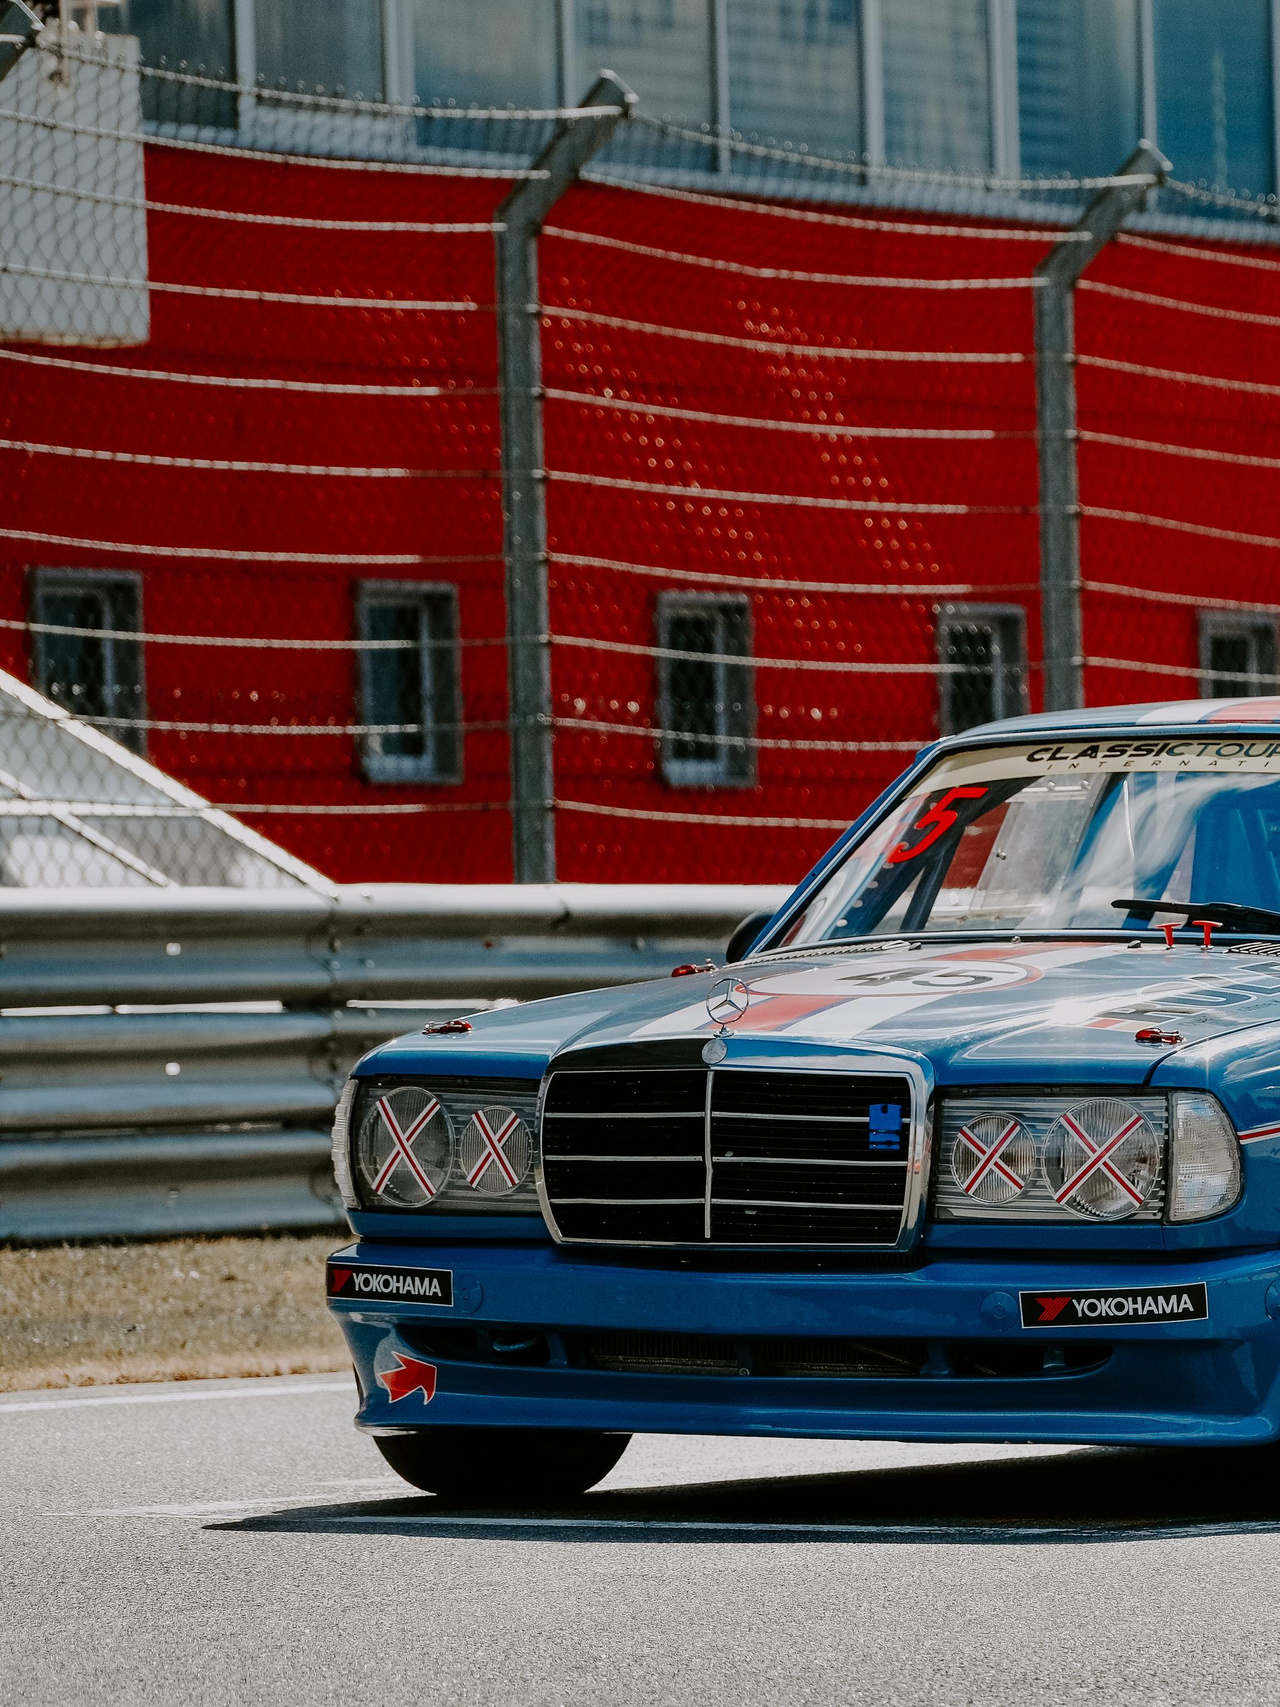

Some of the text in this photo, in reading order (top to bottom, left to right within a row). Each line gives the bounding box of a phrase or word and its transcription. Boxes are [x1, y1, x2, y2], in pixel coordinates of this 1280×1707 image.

[835, 966, 1019, 987] 45
[353, 1272, 442, 1297] YOKOHAMA
[1072, 1293, 1194, 1318] YOKOHAMA
